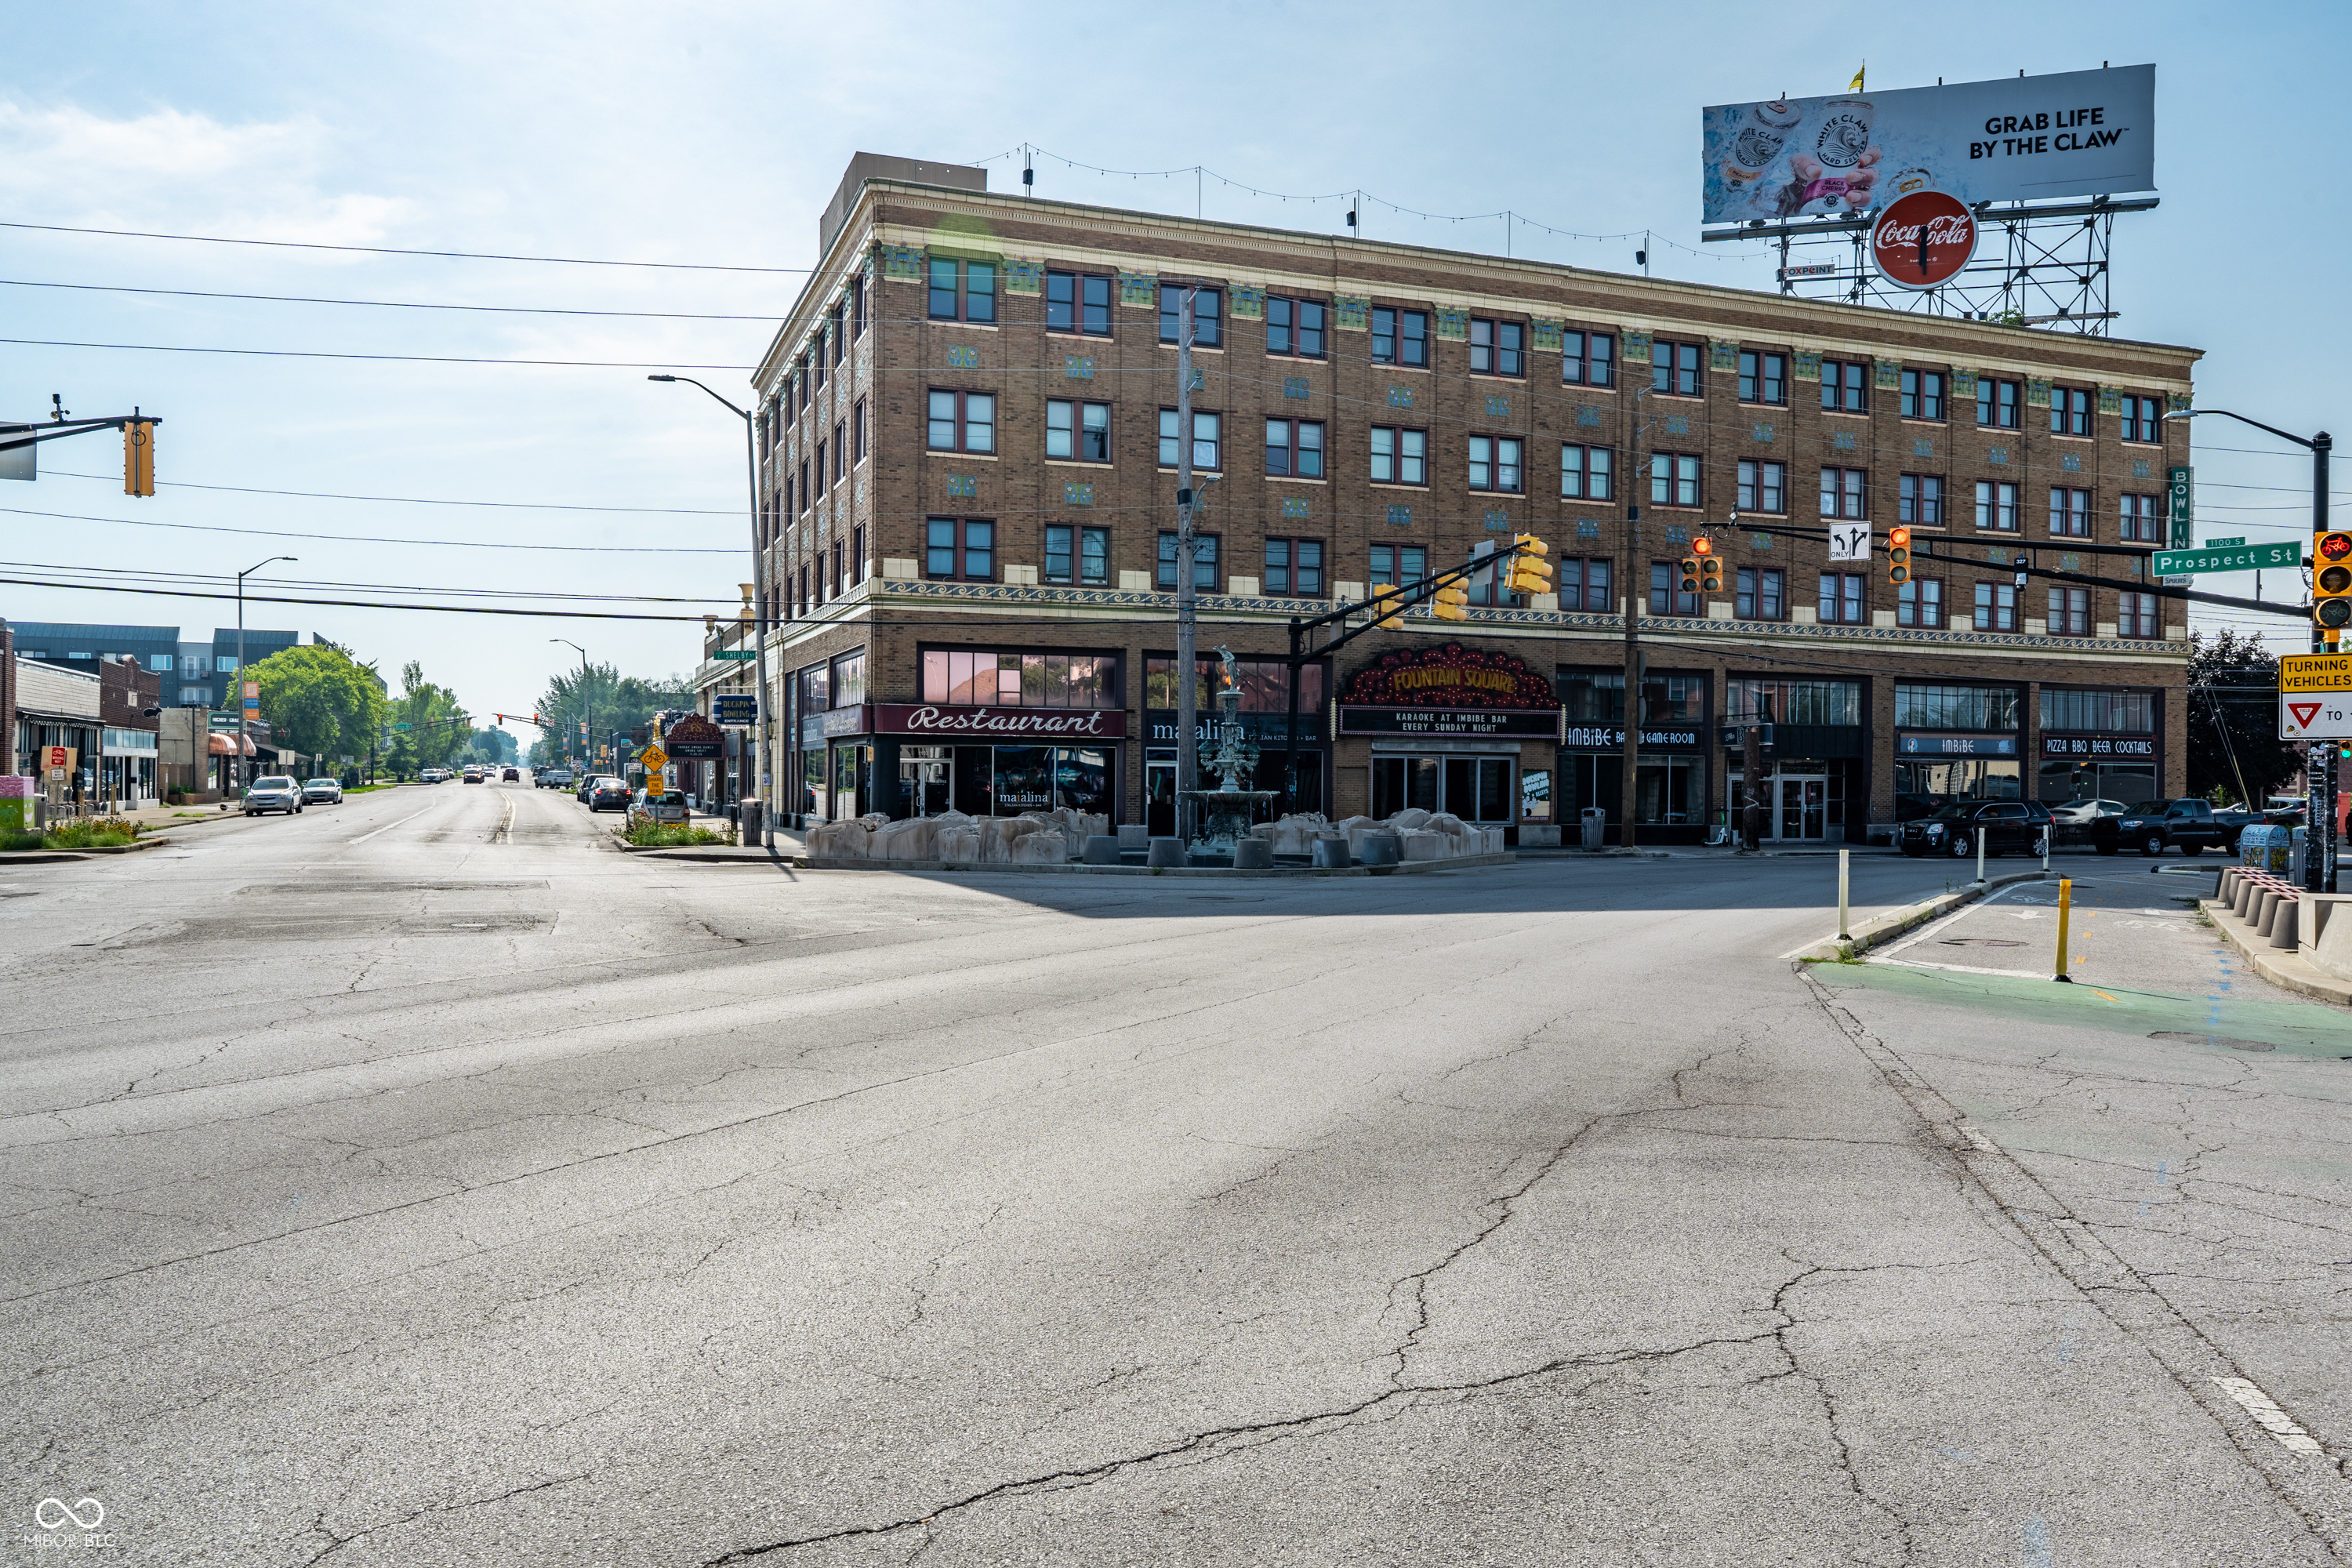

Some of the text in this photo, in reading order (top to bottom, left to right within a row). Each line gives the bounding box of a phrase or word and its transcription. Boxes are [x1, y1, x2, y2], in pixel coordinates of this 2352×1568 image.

[1985, 107, 2104, 135] GRAB LIFE
[1737, 127, 1784, 144] WHITE CLAW
[1817, 117, 1838, 148] WHITE
[1841, 114, 1868, 132] CLAW
[1969, 140, 1998, 159] BY
[2002, 135, 2048, 156] THE
[2054, 128, 2123, 151] CLAW
[1737, 149, 1751, 165] HARD
[1821, 152, 1842, 165] HARD
[1732, 170, 1751, 180] PEACH
[1875, 214, 1970, 249] CocaCola
[1783, 265, 1832, 275] FOXPOINT
[2175, 471, 2187, 548] BOWLIN
[2161, 549, 2292, 570] Prospect St
[2286, 659, 2348, 673] TURNING
[1394, 669, 1515, 694] FOUNTAIN SQUARE
[2285, 674, 2351, 687] VEHICLES
[907, 706, 1104, 735] Restaurant
[1396, 713, 1434, 721] KARAOKE
[1440, 713, 1450, 722] AT
[1457, 714, 1485, 723] IMBIBE
[2326, 710, 2343, 720] TO
[691, 723, 702, 732] FS
[1435, 723, 1466, 731] SUNDAY
[1646, 732, 1668, 743] GAME
[1670, 733, 1695, 744] ROOM
[2047, 739, 2152, 753] PIZZA BBQ BEER COCKTAILS
[1000, 791, 1048, 802] maialina
